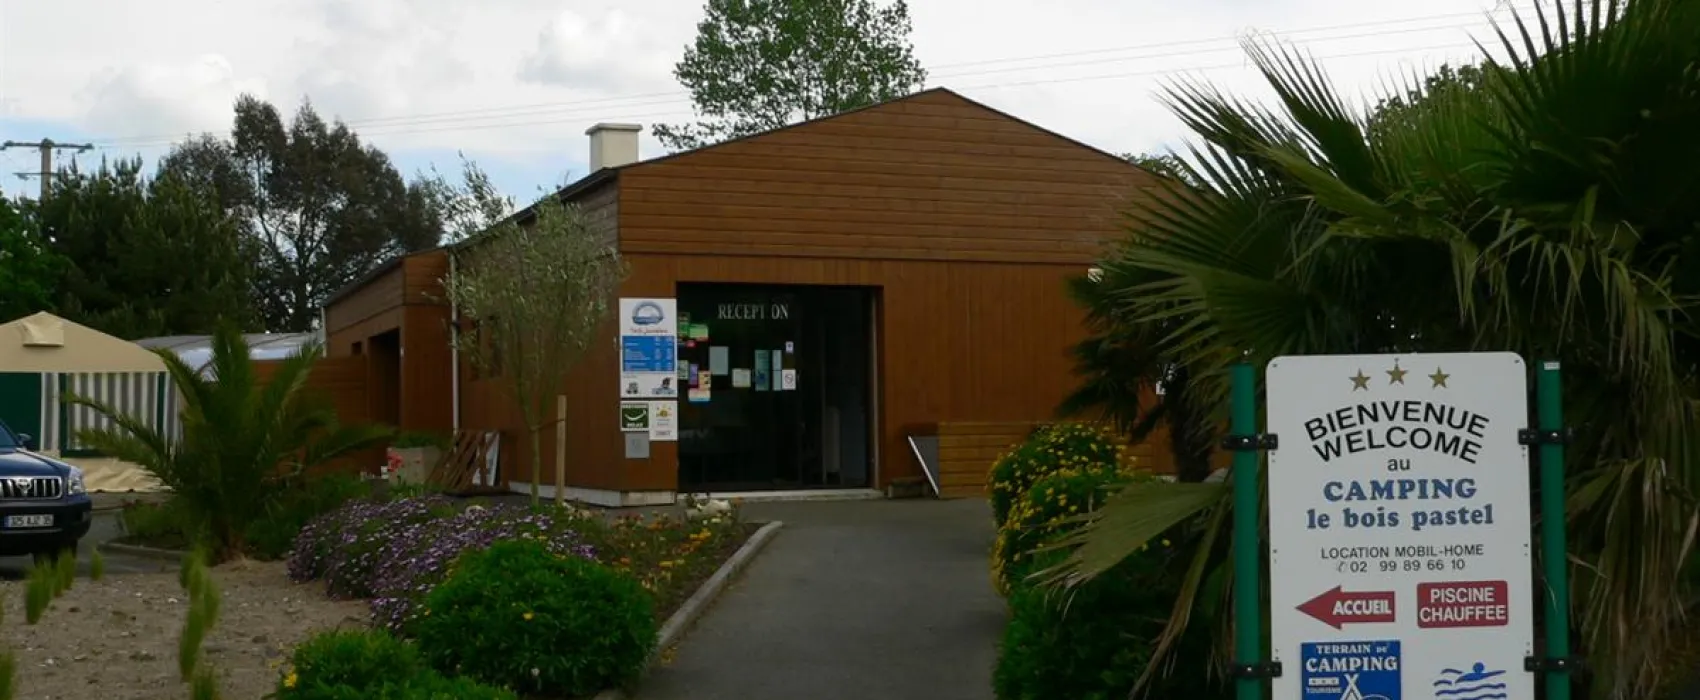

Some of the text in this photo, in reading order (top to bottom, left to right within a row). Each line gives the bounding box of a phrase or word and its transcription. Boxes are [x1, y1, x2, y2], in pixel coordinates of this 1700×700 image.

[1304, 400, 1489, 442] BIENVENUE
[1312, 426, 1482, 464] WELCOME
[1387, 458, 1411, 471] au
[1323, 478, 1477, 502] CAMPING
[1306, 503, 1493, 531] le bois pastel
[1321, 543, 1484, 560] LOCATION MOBIL-HOME
[1350, 559, 1466, 573] 02 99 89 66 10
[1430, 587, 1495, 603] PISCINE
[1332, 600, 1392, 616] ACCUEIL
[1419, 605, 1506, 622] CHAUFFEE
[1316, 644, 1371, 654] TERRAIN
[1305, 656, 1398, 672] CAMPING
